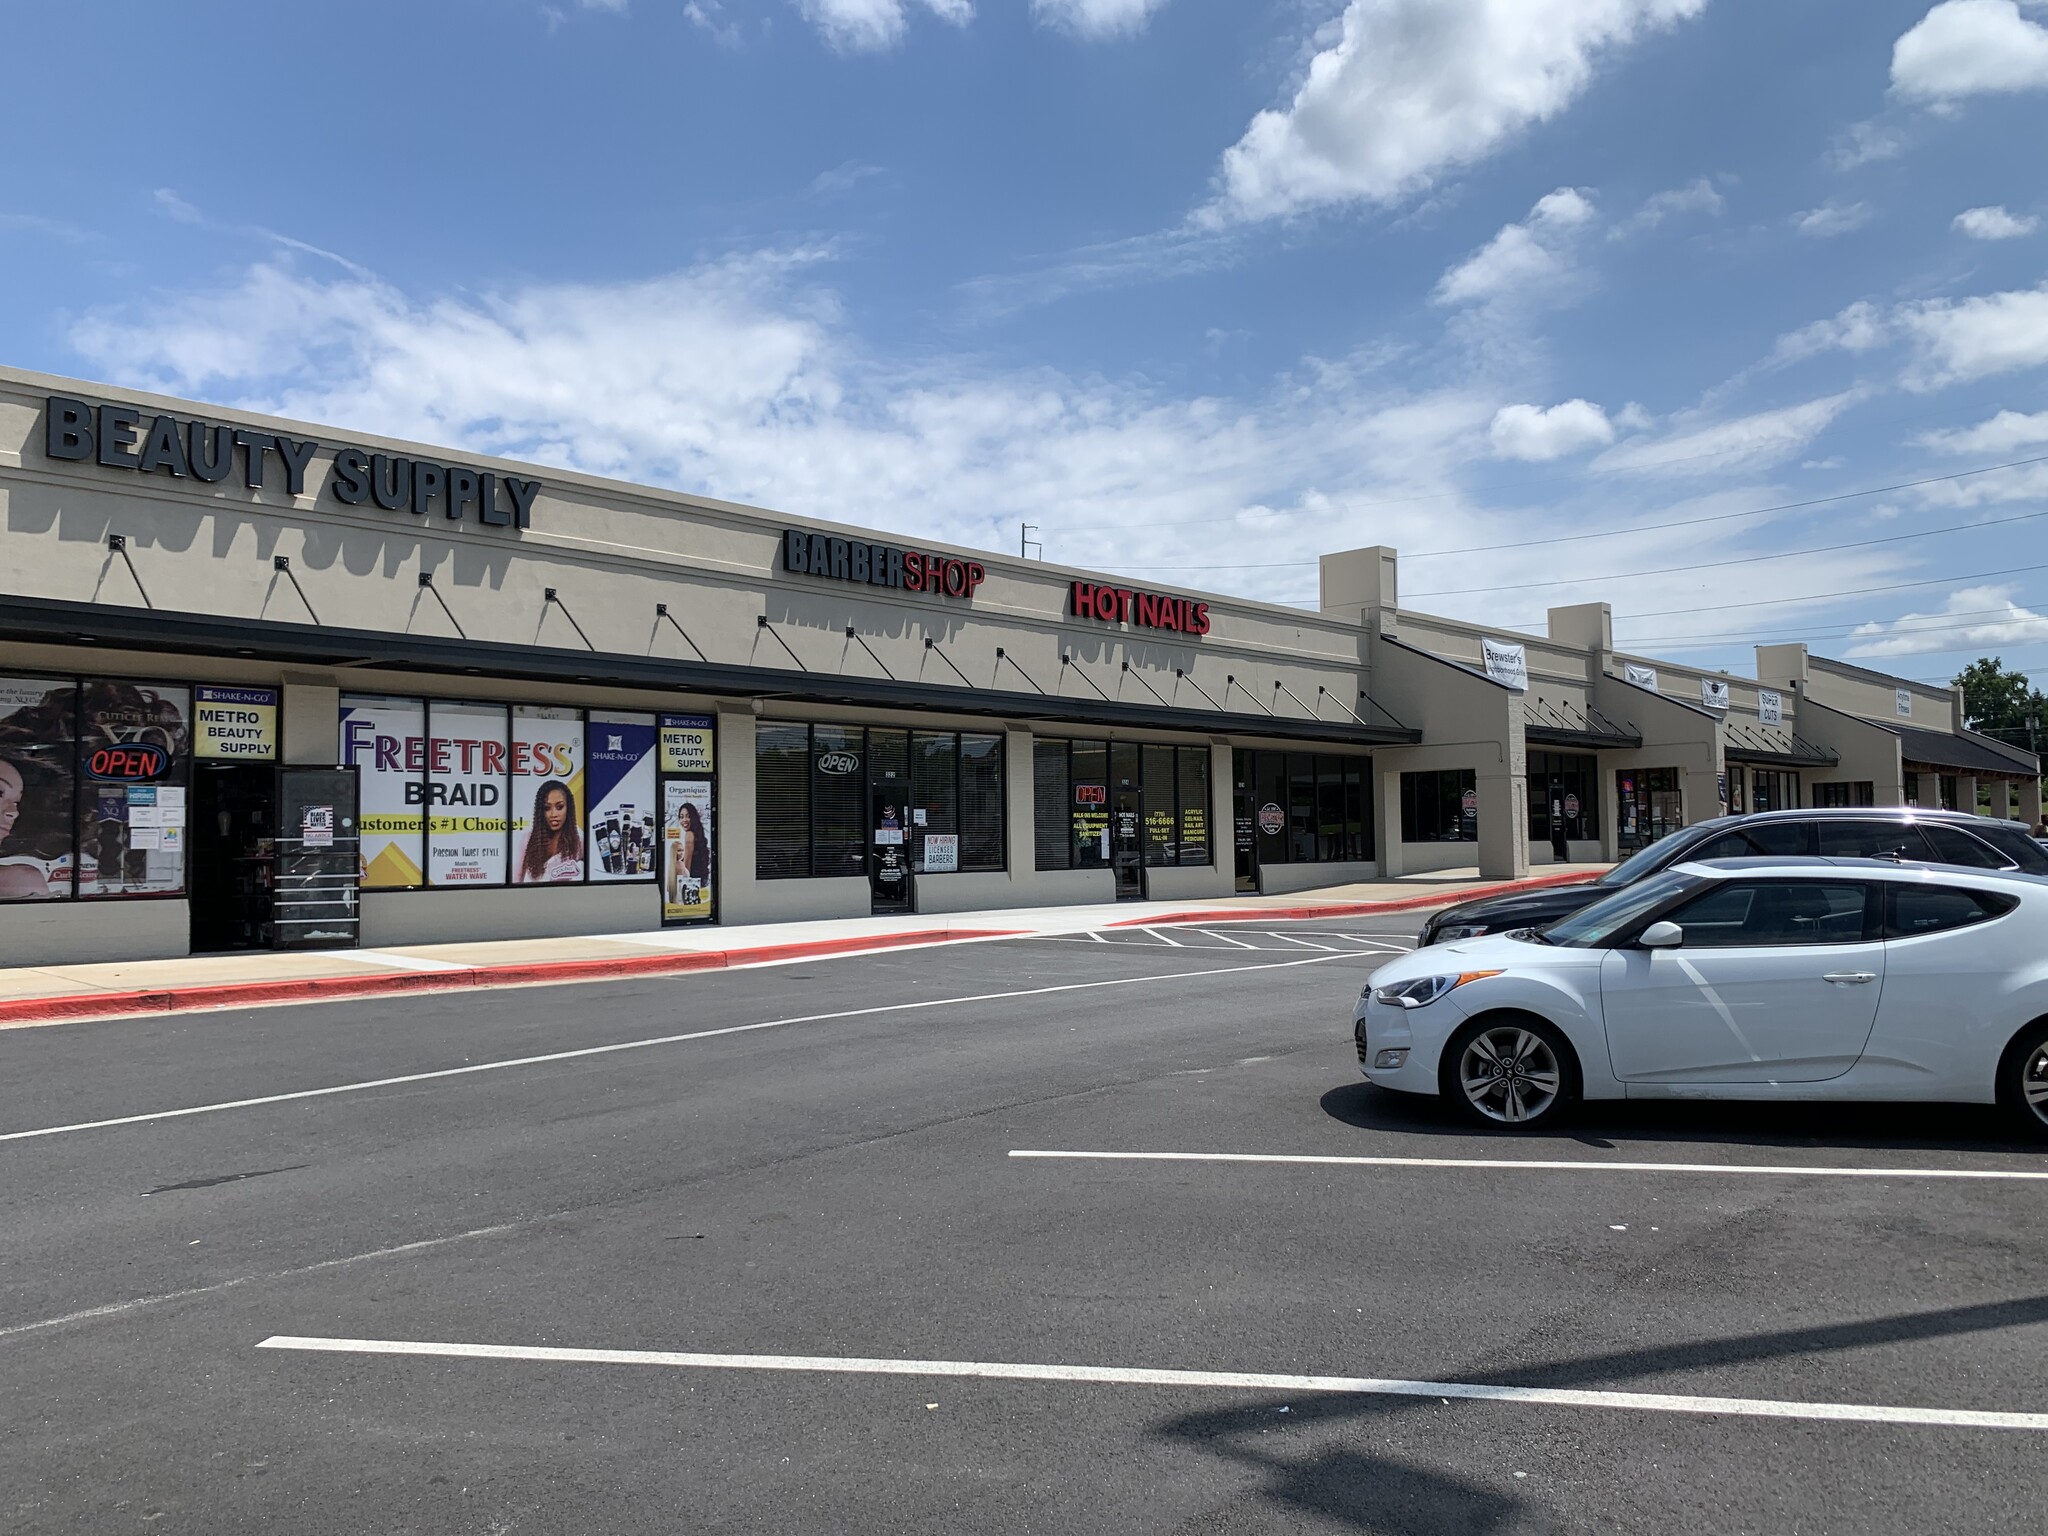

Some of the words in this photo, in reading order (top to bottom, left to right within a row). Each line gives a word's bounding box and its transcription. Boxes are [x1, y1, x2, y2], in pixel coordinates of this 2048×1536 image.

[46, 395, 318, 495] BEAUTY
[332, 447, 542, 529] SUPPLY
[783, 529, 985, 598] BARBERSHOP
[1070, 581, 1132, 623] HOT
[1135, 591, 1210, 635] NAILS
[1486, 648, 1522, 665] Brewster's
[212, 691, 269, 702] SHAKE-N-GO
[1761, 693, 1778, 706] SUPER
[199, 709, 259, 724] METRO
[1764, 708, 1777, 721] CUTS
[208, 727, 263, 739] BEAUTY
[663, 733, 702, 744] METRO
[220, 742, 272, 754] SUPPLY
[669, 747, 705, 756] BEAUTY
[592, 751, 638, 761] SHAKE-N-GO
[91, 749, 158, 776] OPEN
[677, 759, 711, 768] SUPPLY
[820, 753, 855, 773] OPEN
[404, 781, 500, 806] BRAID
[1077, 786, 1105, 802] OPEN
[440, 817, 458, 831] #1
[463, 816, 524, 831] Choice!
[1144, 817, 1175, 825] 516-6666
[927, 836, 938, 845] NOW
[939, 836, 956, 845] HIRING
[928, 845, 954, 854] LICENSED
[928, 854, 954, 864] BARBERS
[469, 872, 488, 880] WAVE
